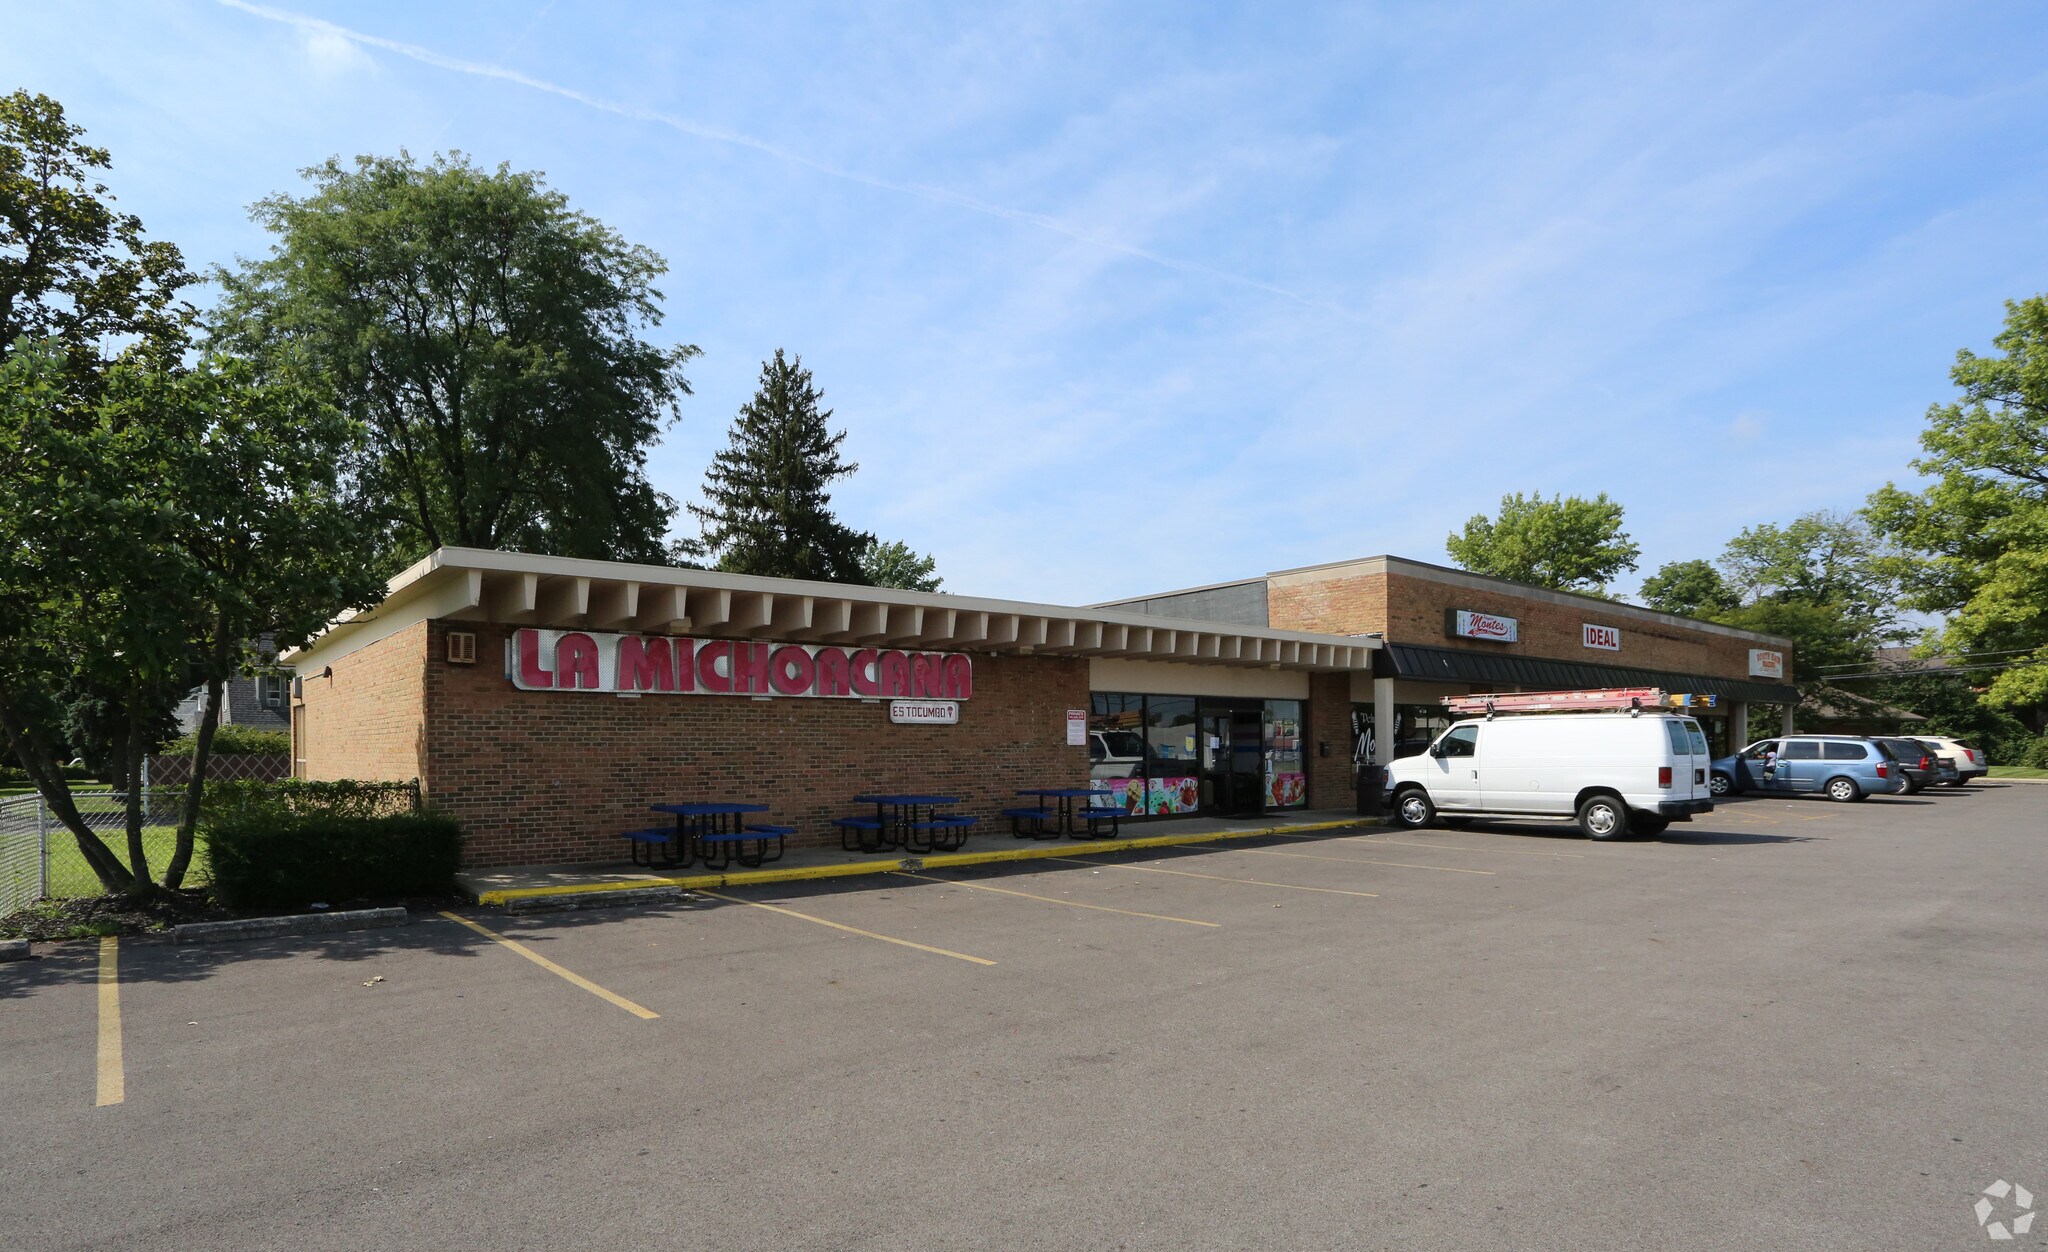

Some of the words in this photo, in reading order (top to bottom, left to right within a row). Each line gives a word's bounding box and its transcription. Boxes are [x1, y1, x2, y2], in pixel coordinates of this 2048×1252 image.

[1470, 613, 1505, 631] Montes
[1586, 626, 1617, 647] IDEAL
[520, 628, 600, 689] LA
[617, 635, 972, 698] MICHOACANA
[893, 706, 905, 717] ES
[906, 706, 946, 718] TOCUMBO
